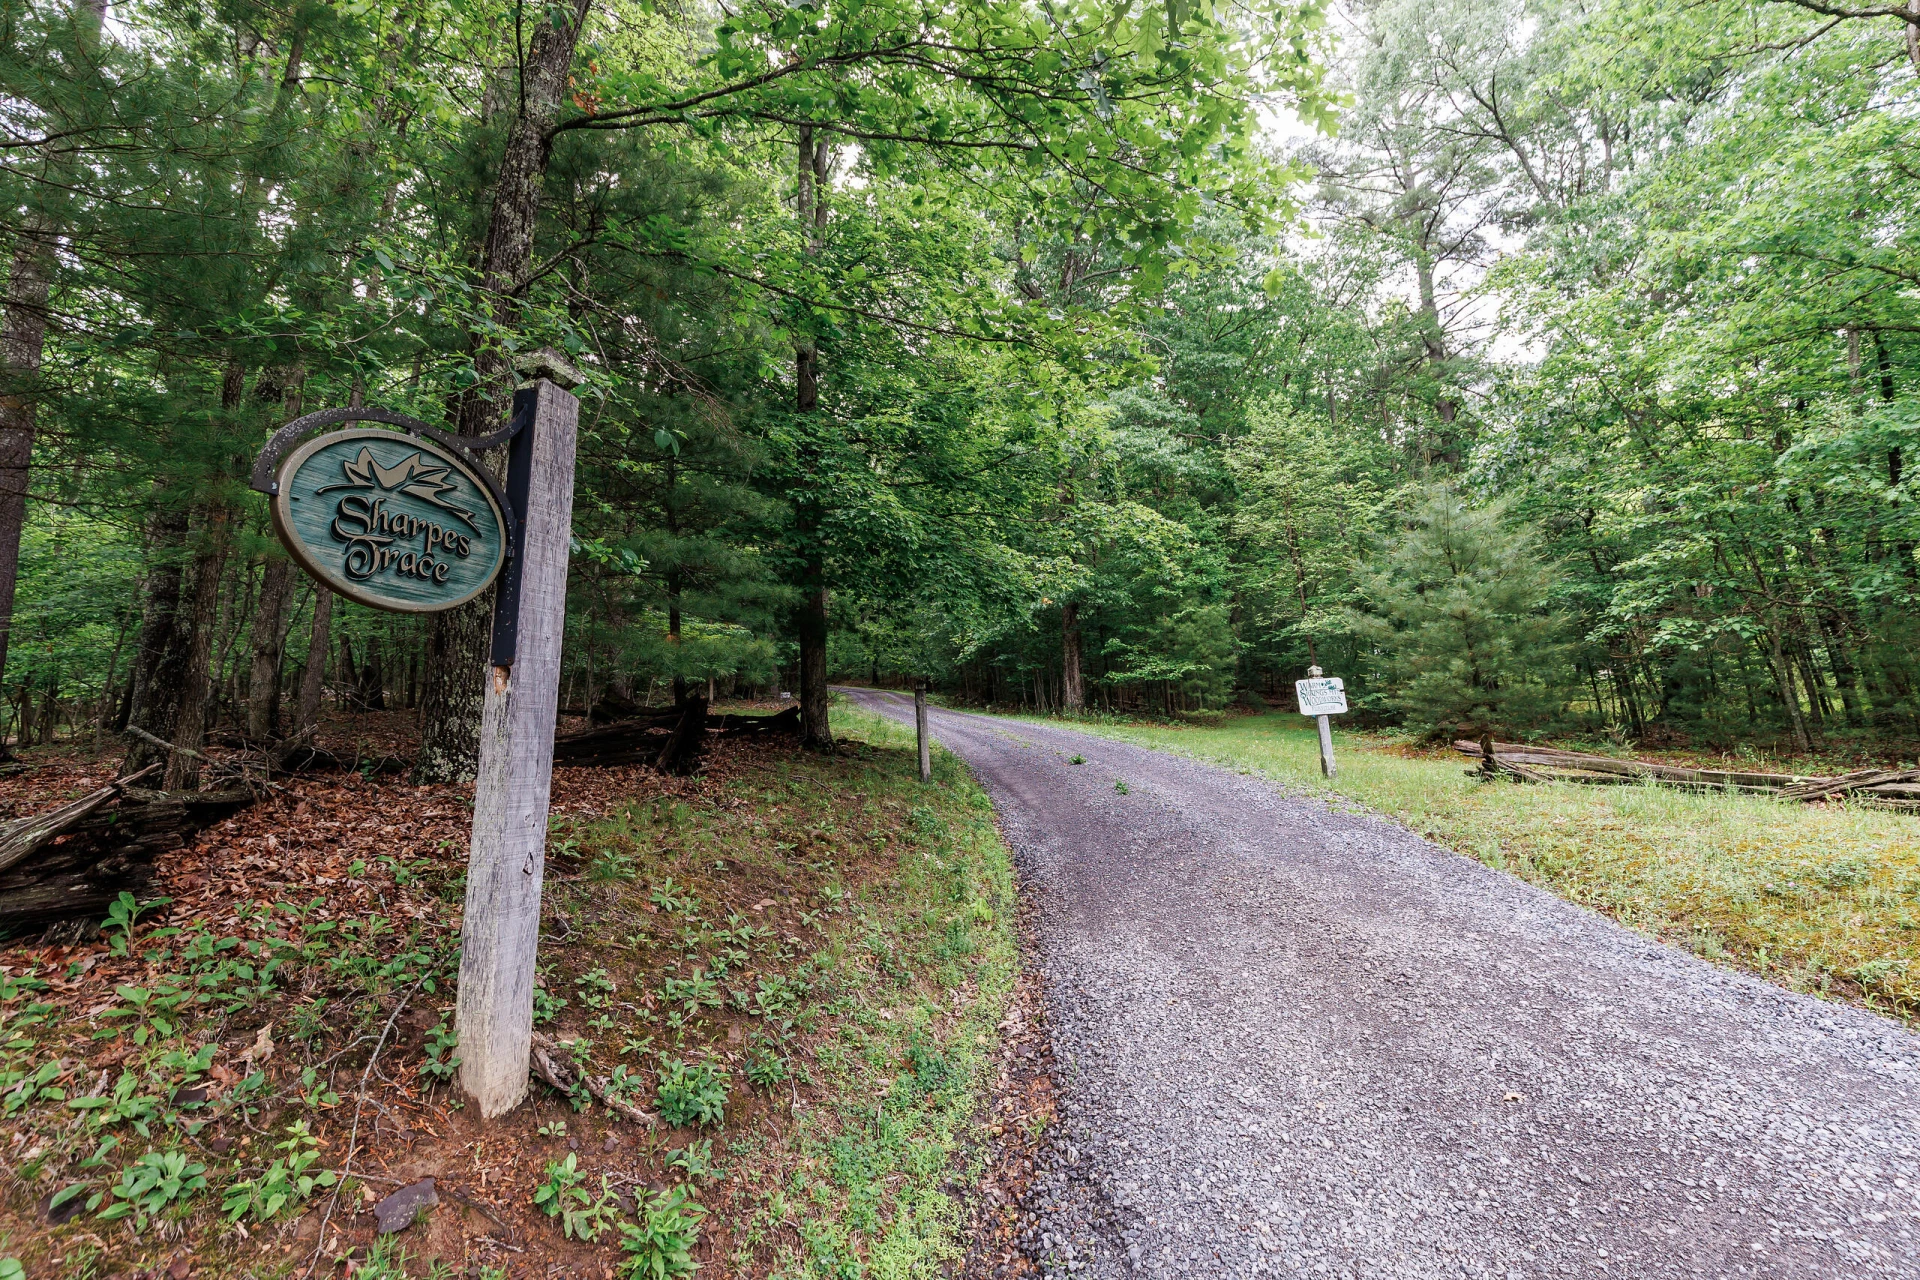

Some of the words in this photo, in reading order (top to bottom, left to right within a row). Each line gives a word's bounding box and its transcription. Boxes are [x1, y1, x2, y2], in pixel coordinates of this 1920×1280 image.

[330, 495, 472, 558] Sharpes
[344, 534, 450, 586] Trace
[1298, 682, 1321, 691] WARM
